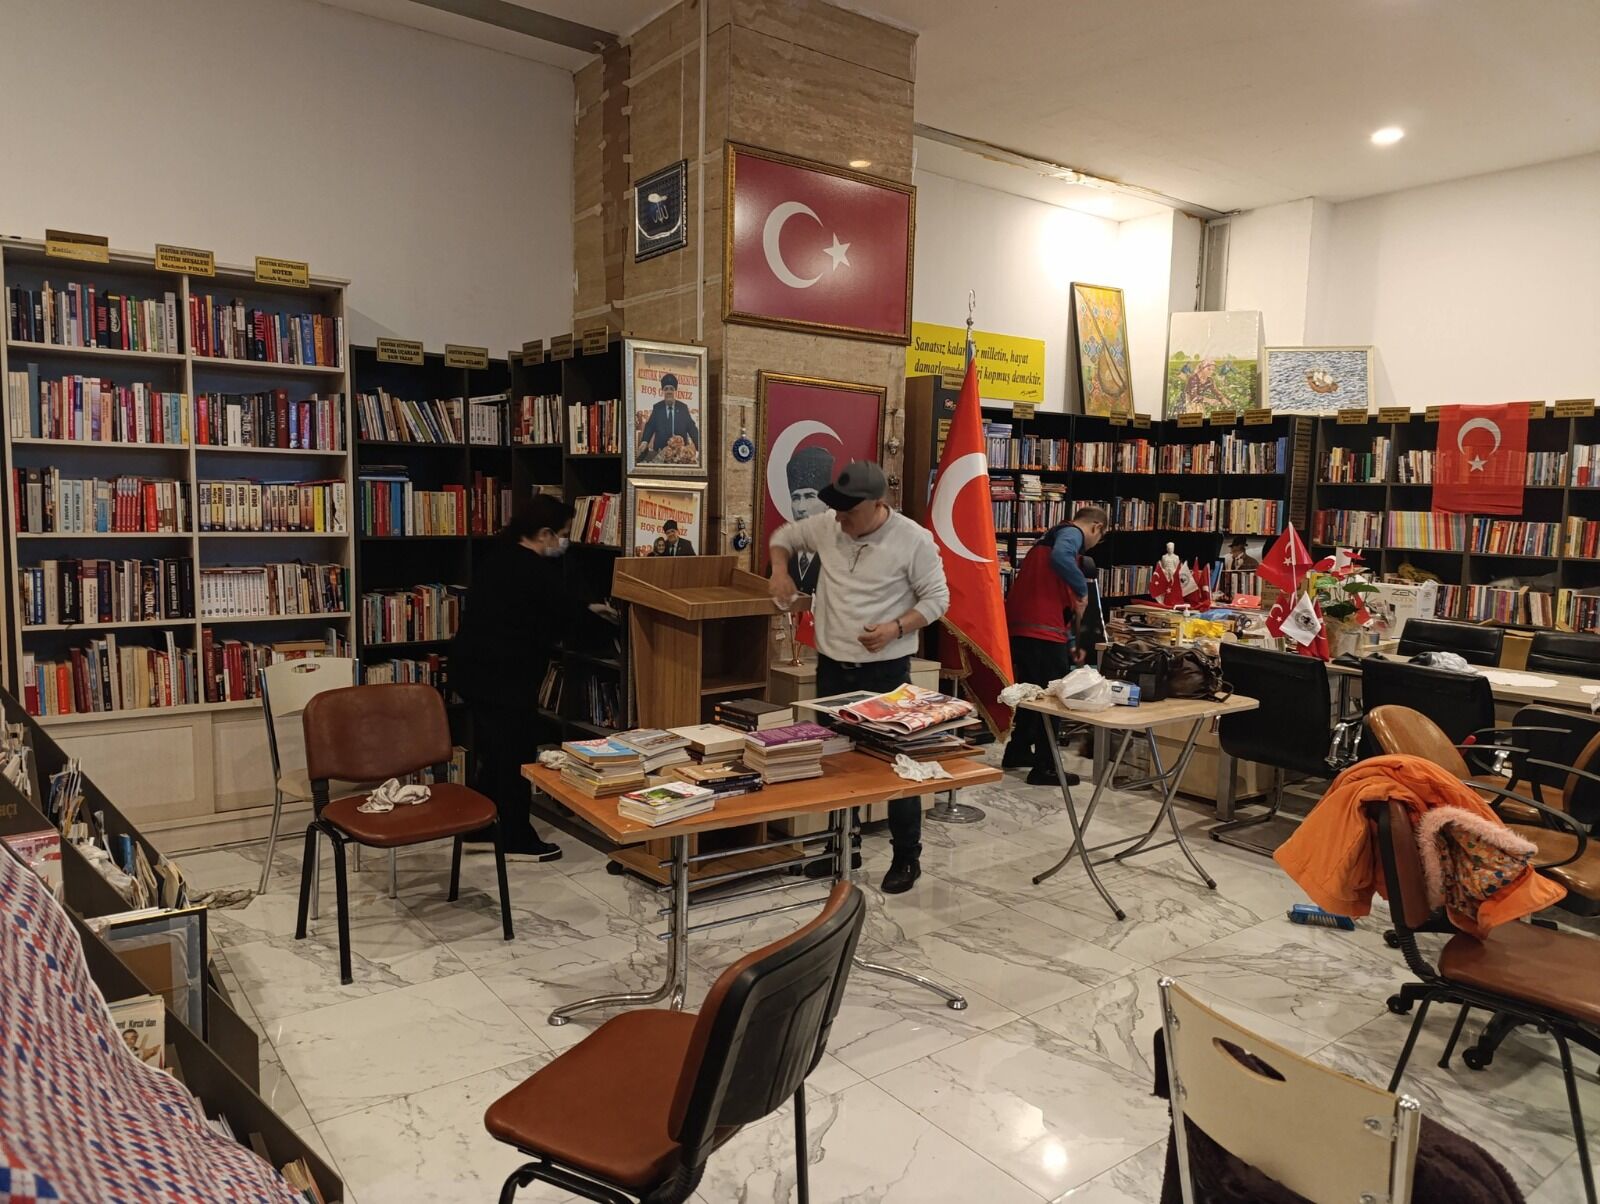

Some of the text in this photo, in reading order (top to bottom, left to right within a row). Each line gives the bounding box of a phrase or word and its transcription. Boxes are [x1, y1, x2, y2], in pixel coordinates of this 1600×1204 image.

[188, 265, 208, 273] PINAR
[98, 306, 108, 332] NUTUK
[254, 311, 265, 341] NUTUK
[914, 336, 946, 356] Sanatsız
[980, 346, 1009, 363] milletin,
[1010, 350, 1029, 366] hayat
[984, 367, 1010, 385] kopmuş
[1011, 370, 1042, 386] demektir.
[641, 385, 657, 398] HOŞ
[640, 522, 656, 535] HOŞ
[1391, 588, 1418, 598] ZEN
[144, 591, 155, 614] NUTUK
[128, 1018, 157, 1029] Kırca'dan
